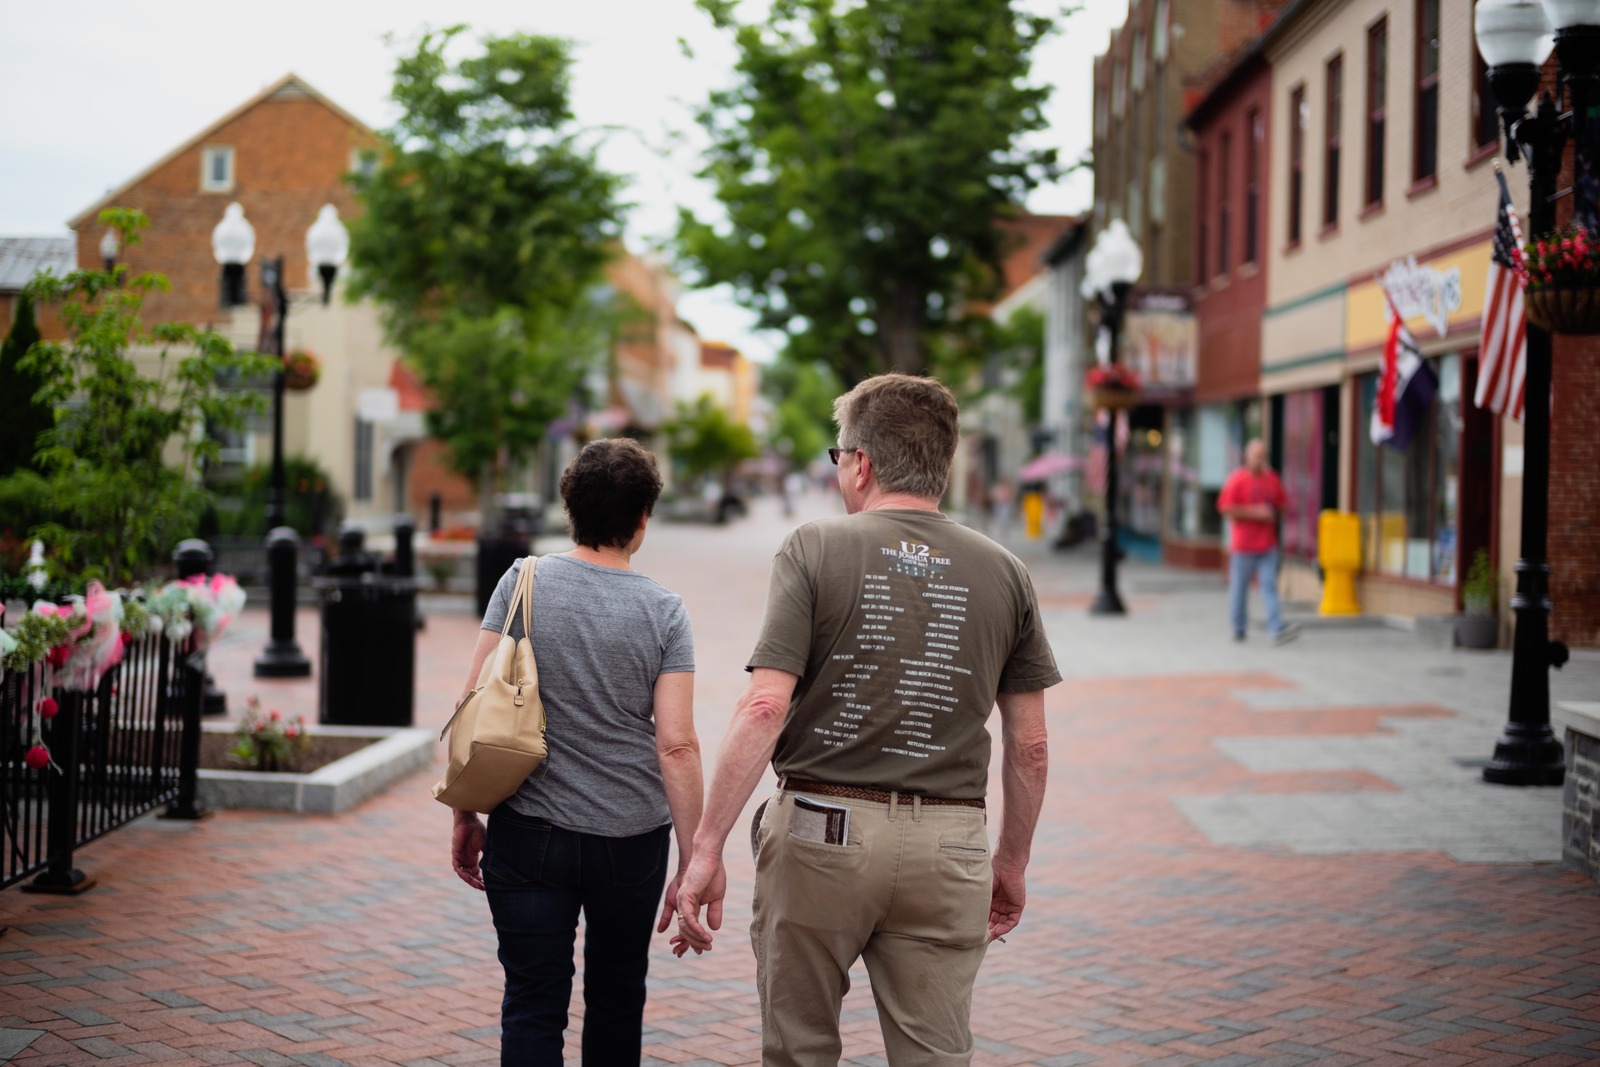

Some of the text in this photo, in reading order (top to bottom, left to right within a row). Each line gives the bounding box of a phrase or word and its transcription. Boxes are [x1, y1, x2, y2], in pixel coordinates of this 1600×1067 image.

[880, 548, 898, 556] THE
[930, 557, 951, 565] TREE
[900, 541, 929, 557] U2
